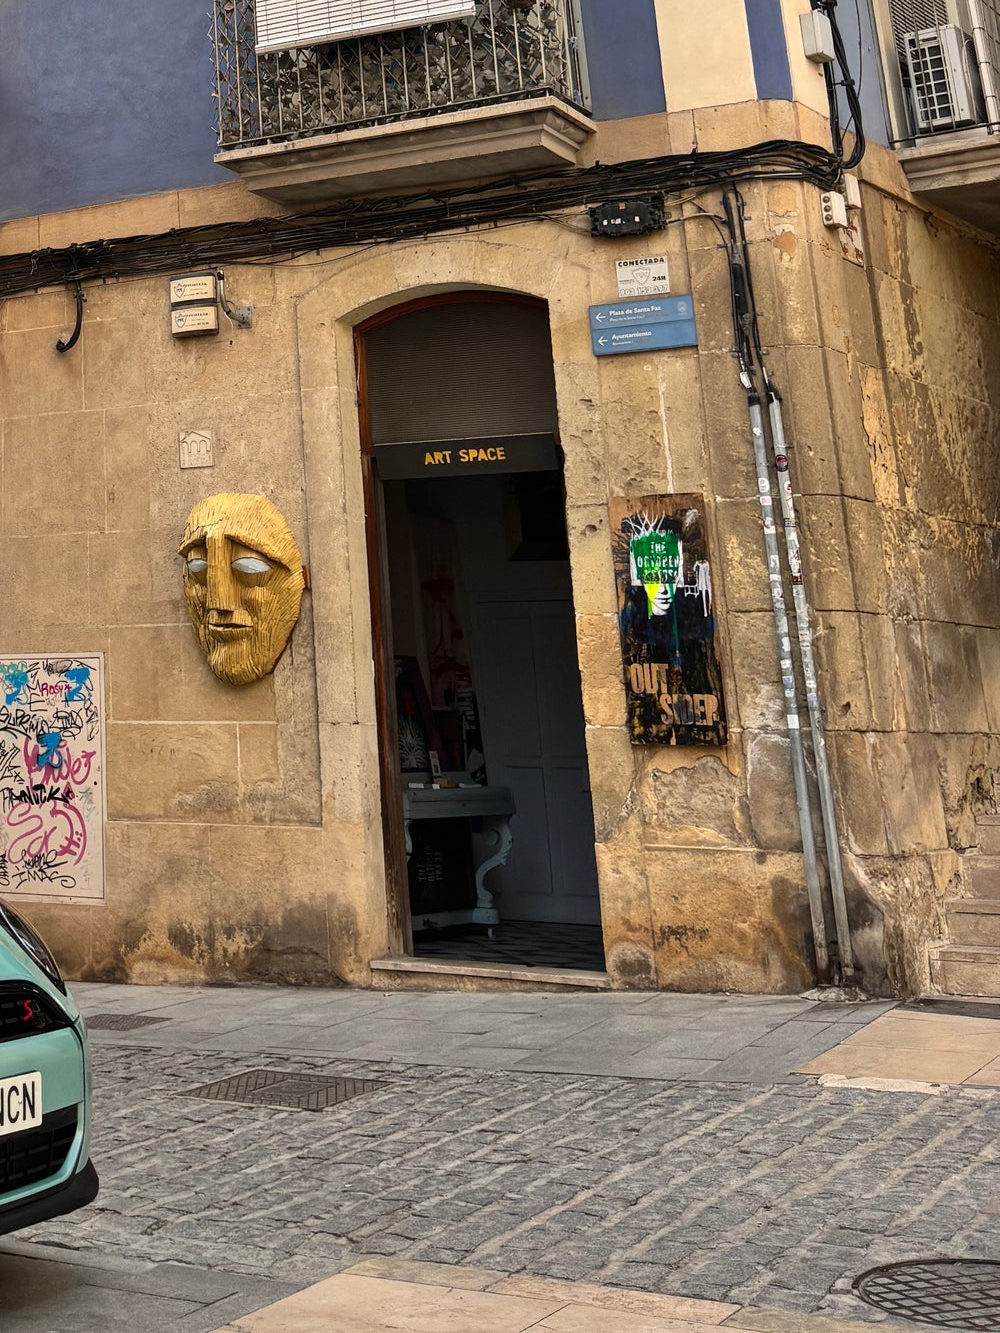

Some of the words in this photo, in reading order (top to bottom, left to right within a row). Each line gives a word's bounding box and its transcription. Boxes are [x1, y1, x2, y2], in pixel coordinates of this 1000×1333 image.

[617, 256, 665, 267] CONECTADA
[612, 331, 652, 340] Ayuntamiento
[424, 450, 452, 465] ART
[458, 447, 506, 462] SPACE
[630, 663, 669, 694] OUT
